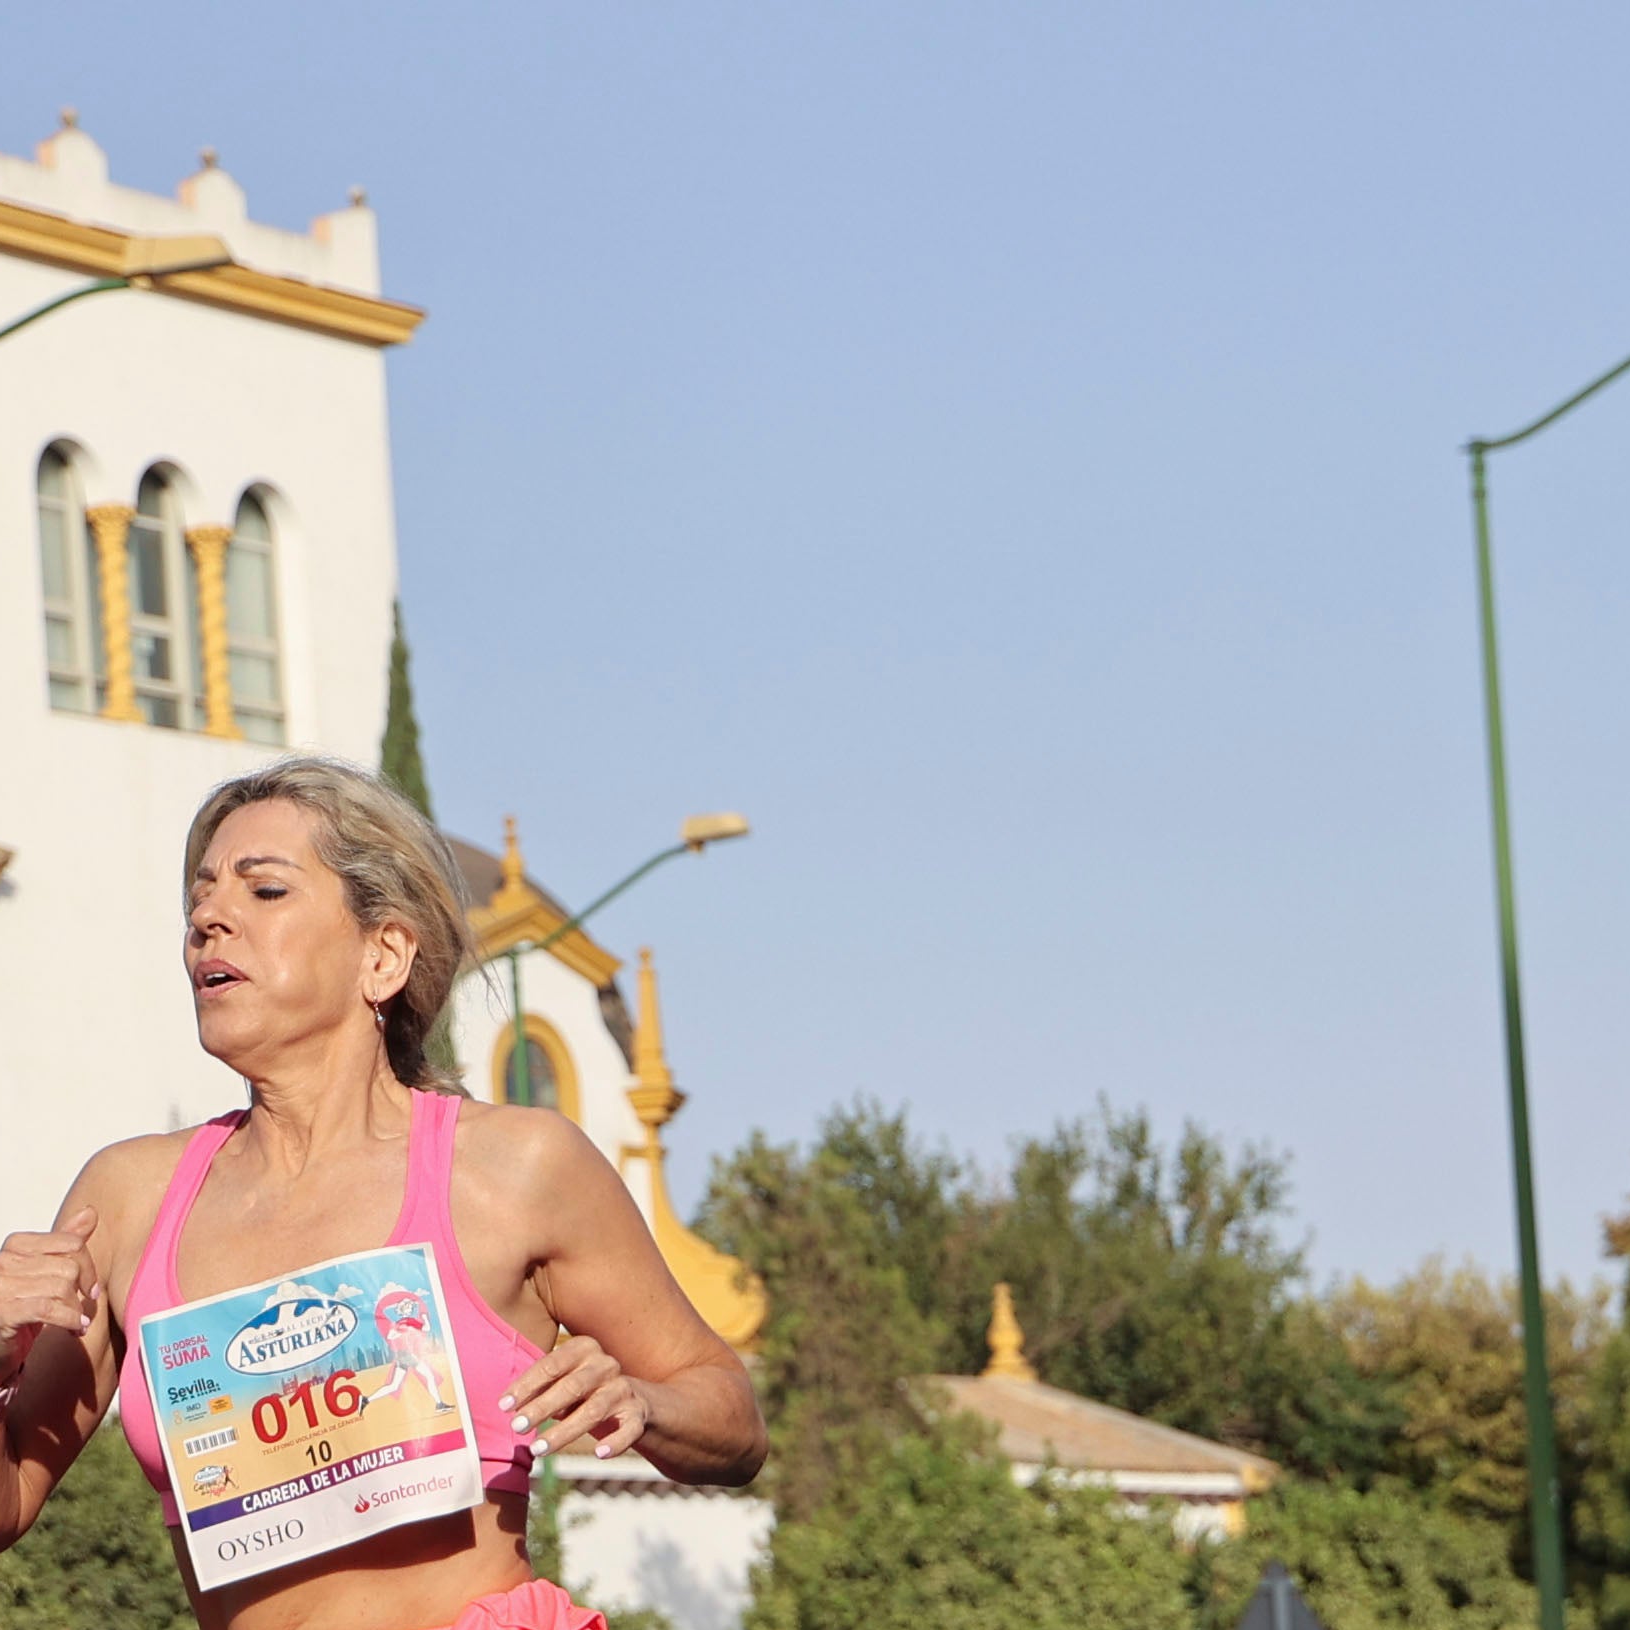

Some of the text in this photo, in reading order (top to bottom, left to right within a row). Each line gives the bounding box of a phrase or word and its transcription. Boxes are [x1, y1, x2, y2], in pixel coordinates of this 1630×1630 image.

[162, 1345, 211, 1370] SUMA
[238, 1317, 348, 1368] ASTURIANA
[252, 1368, 362, 1444] 016
[305, 1440, 332, 1467] 10
[242, 1480, 310, 1513] CARRERA
[311, 1471, 331, 1490] DE
[333, 1463, 351, 1483] LA
[352, 1446, 405, 1475] MUJER
[370, 1475, 455, 1508] Santander
[218, 1519, 304, 1561] OYSHO
